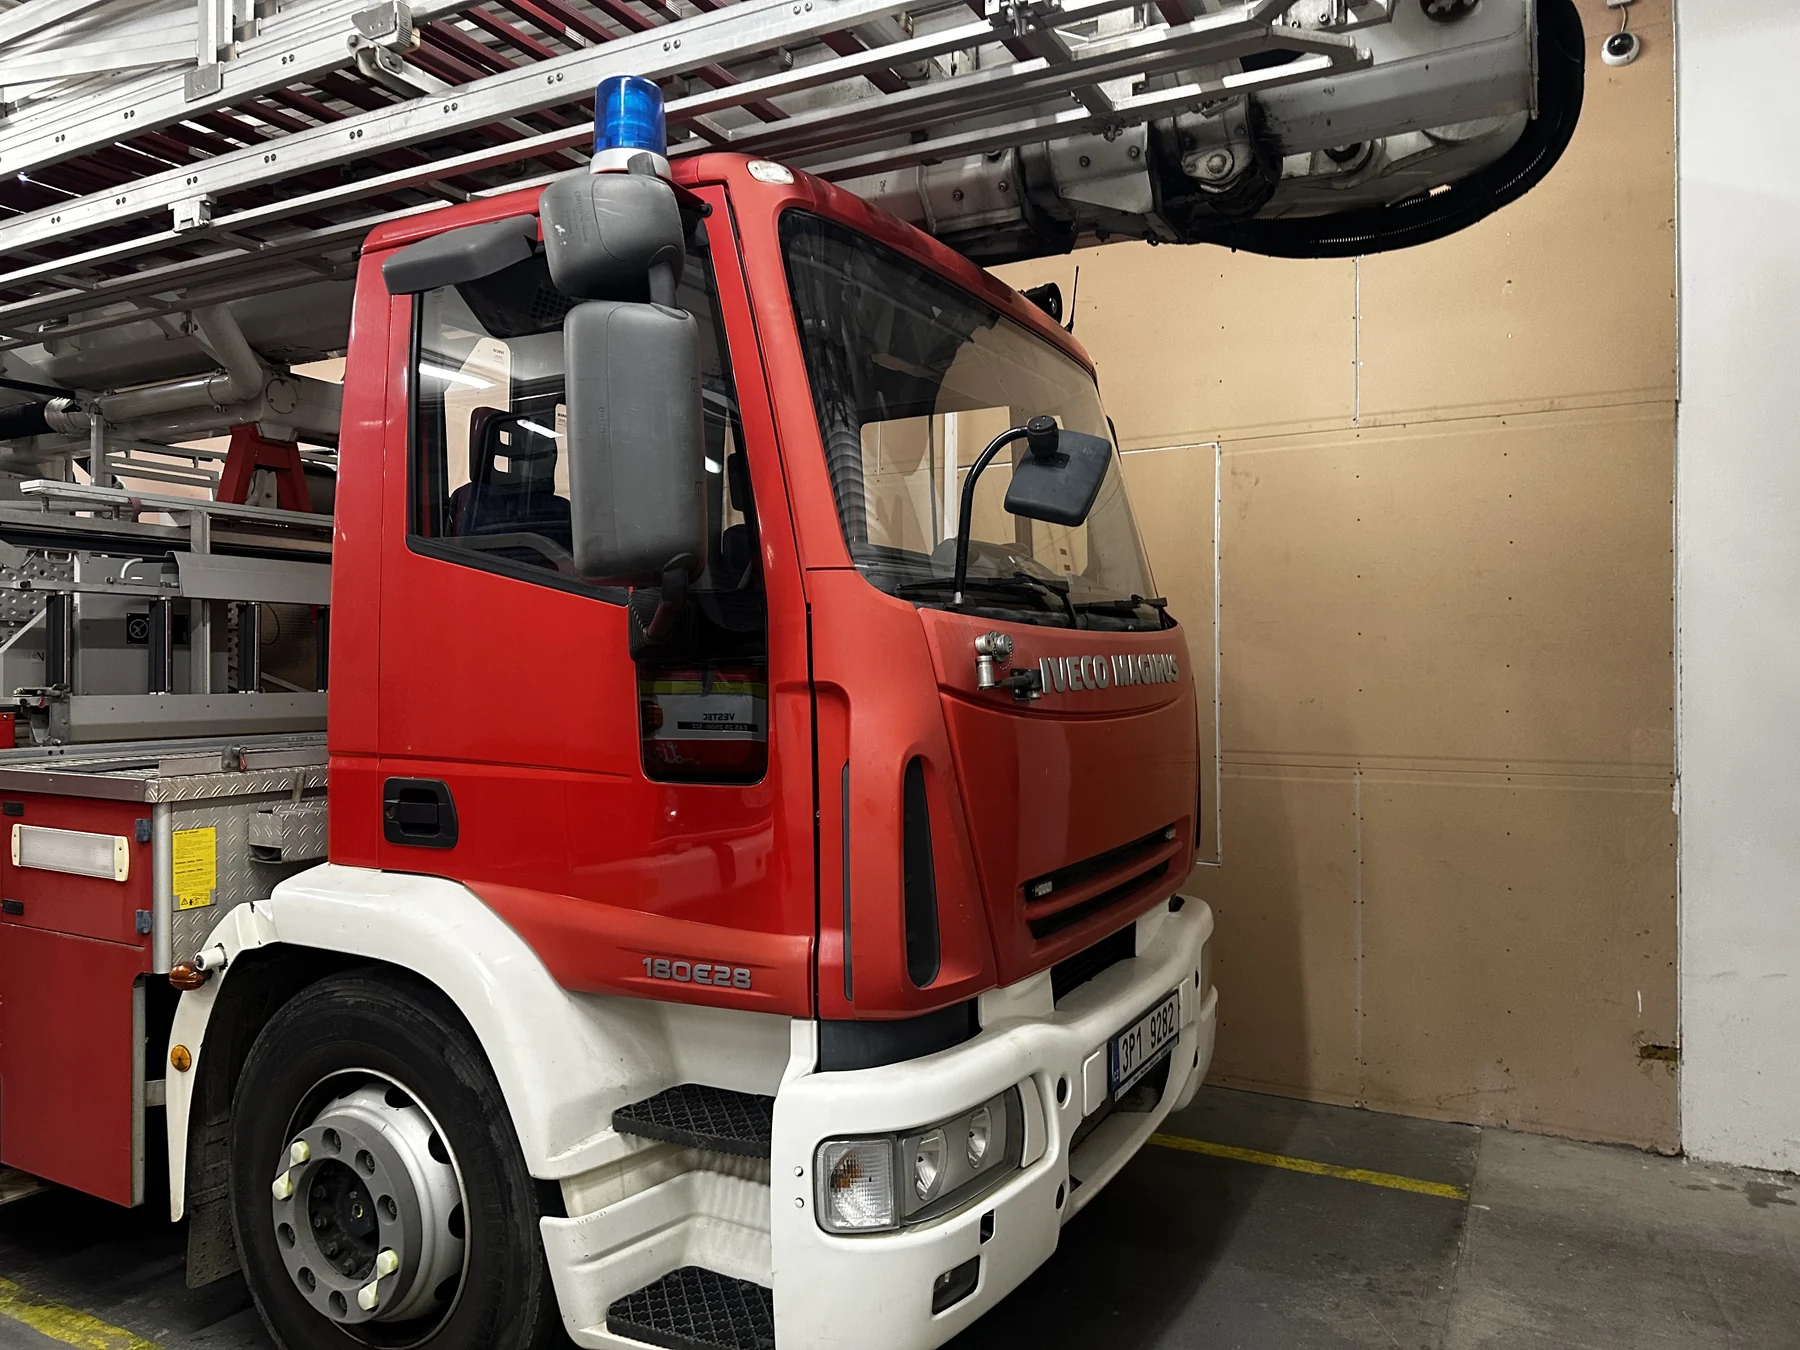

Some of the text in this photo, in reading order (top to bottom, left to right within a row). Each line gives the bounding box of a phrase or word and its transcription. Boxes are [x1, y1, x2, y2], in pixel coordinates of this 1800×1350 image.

[1038, 653, 1179, 694] IVECO MAGIRUS
[642, 957, 752, 989] 180E28
[1122, 1001, 1175, 1074] 3P1 9282
